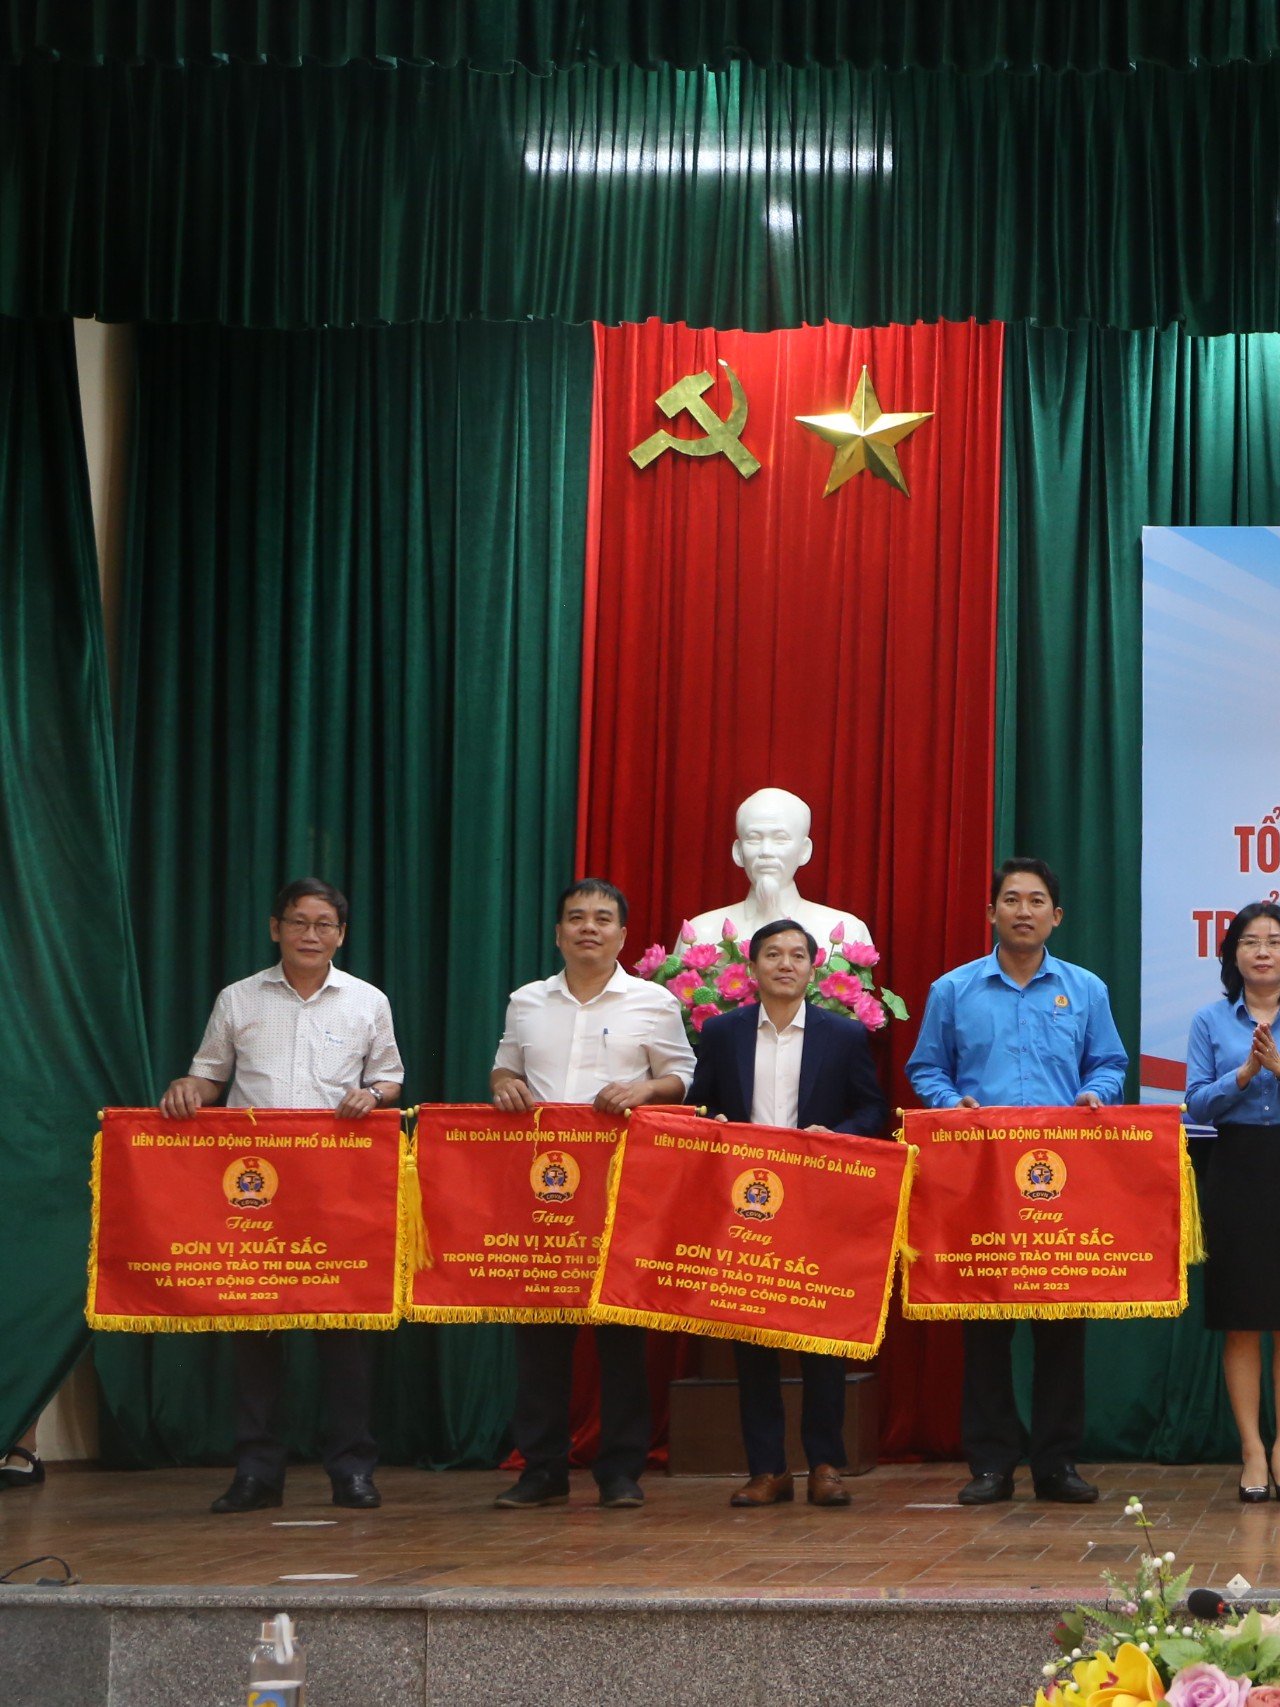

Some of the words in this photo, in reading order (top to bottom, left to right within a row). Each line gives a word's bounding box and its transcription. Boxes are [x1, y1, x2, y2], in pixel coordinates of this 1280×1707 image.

[131, 1132, 154, 1147] LIÊN
[156, 1133, 190, 1147] ĐOÀN
[192, 1135, 215, 1147] LAO
[217, 1133, 252, 1150] ĐỘNG
[254, 1134, 292, 1148] THÀNH
[294, 1132, 319, 1148] PHỐ
[320, 1134, 337, 1148] ĐÀ
[339, 1132, 372, 1148] NẴNG
[445, 1128, 467, 1141] LIÊN
[469, 1128, 501, 1142] ĐOÀN
[502, 1130, 524, 1142] LAO
[557, 1128, 592, 1142] THÀNH
[594, 1127, 617, 1143] PHỐ
[931, 1128, 952, 1142] LIÊN
[954, 1127, 985, 1141] ĐOÀN
[986, 1128, 1007, 1140] LAO
[1008, 1126, 1041, 1142] ĐỘNG
[1042, 1126, 1078, 1140] THÀNH
[1079, 1125, 1102, 1140] PHỐ
[1104, 1126, 1120, 1140] ĐÀ
[1121, 1125, 1153, 1141] NẴNG
[654, 1133, 675, 1147] LIÊN
[677, 1137, 709, 1152] ĐOÀN
[709, 1142, 730, 1154] LAO
[731, 1143, 765, 1159] ĐỘNG
[767, 1148, 802, 1165] THÀNH
[802, 1154, 826, 1170] PHỐ
[827, 1158, 842, 1173] ĐÀ
[845, 1159, 876, 1178] NẴNG
[227, 1215, 273, 1232] Tặng
[531, 1209, 575, 1226] Tặng
[1018, 1207, 1063, 1223] Tặng
[483, 1232, 520, 1247] ĐƠN
[523, 1234, 539, 1250] VỊ
[543, 1230, 587, 1248] XUẤT
[728, 1225, 772, 1246] Tặng
[970, 1231, 1006, 1246] ĐƠN
[1010, 1232, 1028, 1248] VỊ
[1032, 1227, 1076, 1245] XUẤT
[1079, 1227, 1114, 1245] SẮC
[170, 1240, 212, 1255] ĐƠN
[216, 1241, 235, 1257] VỊ
[238, 1236, 286, 1254] XUẤT
[290, 1236, 327, 1255] SẮC
[675, 1243, 712, 1260] ĐƠN
[716, 1248, 733, 1265] VỊ
[736, 1251, 781, 1270] XUẤT
[783, 1256, 819, 1276] SẮC
[934, 1252, 973, 1262] TRONG
[974, 1251, 1017, 1261] PHONG
[1019, 1249, 1051, 1261] TRÀO
[1054, 1251, 1073, 1261] THI
[1075, 1251, 1100, 1261] ĐUA
[1103, 1252, 1153, 1261] CNVCLĐ
[959, 1265, 974, 1277] VÀ
[976, 1267, 1008, 1279] HOẠT
[1010, 1265, 1048, 1278] ĐỘNG
[1050, 1264, 1089, 1276] CÔNG
[1090, 1265, 1127, 1276] ĐOÀN
[1013, 1281, 1040, 1290] NĂM
[1043, 1282, 1070, 1290] 2023
[218, 1291, 248, 1300] NĂM
[250, 1291, 279, 1300] 2023
